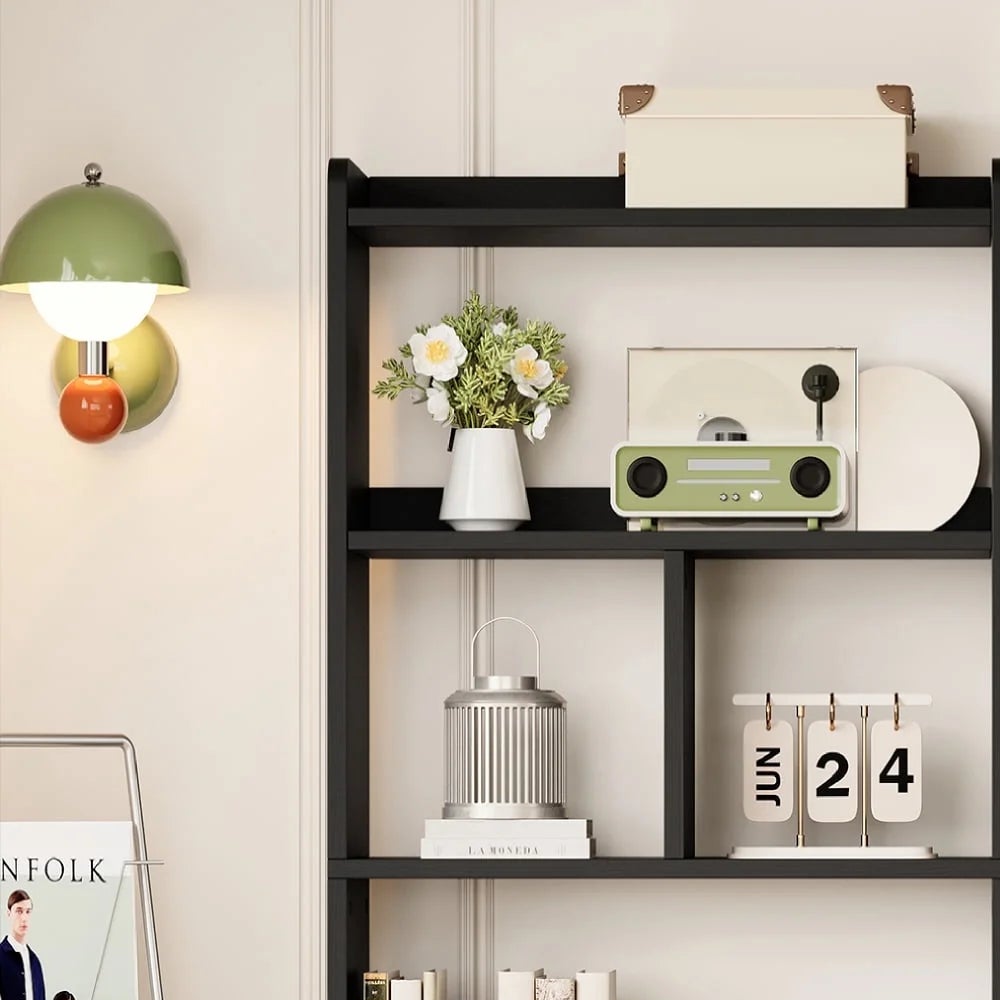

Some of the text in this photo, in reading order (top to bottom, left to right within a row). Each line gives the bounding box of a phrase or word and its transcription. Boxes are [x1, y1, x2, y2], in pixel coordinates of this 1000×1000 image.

[754, 746, 781, 807] JUN
[815, 747, 915, 797] 2 4
[468, 845, 539, 856] LA MONEDA
